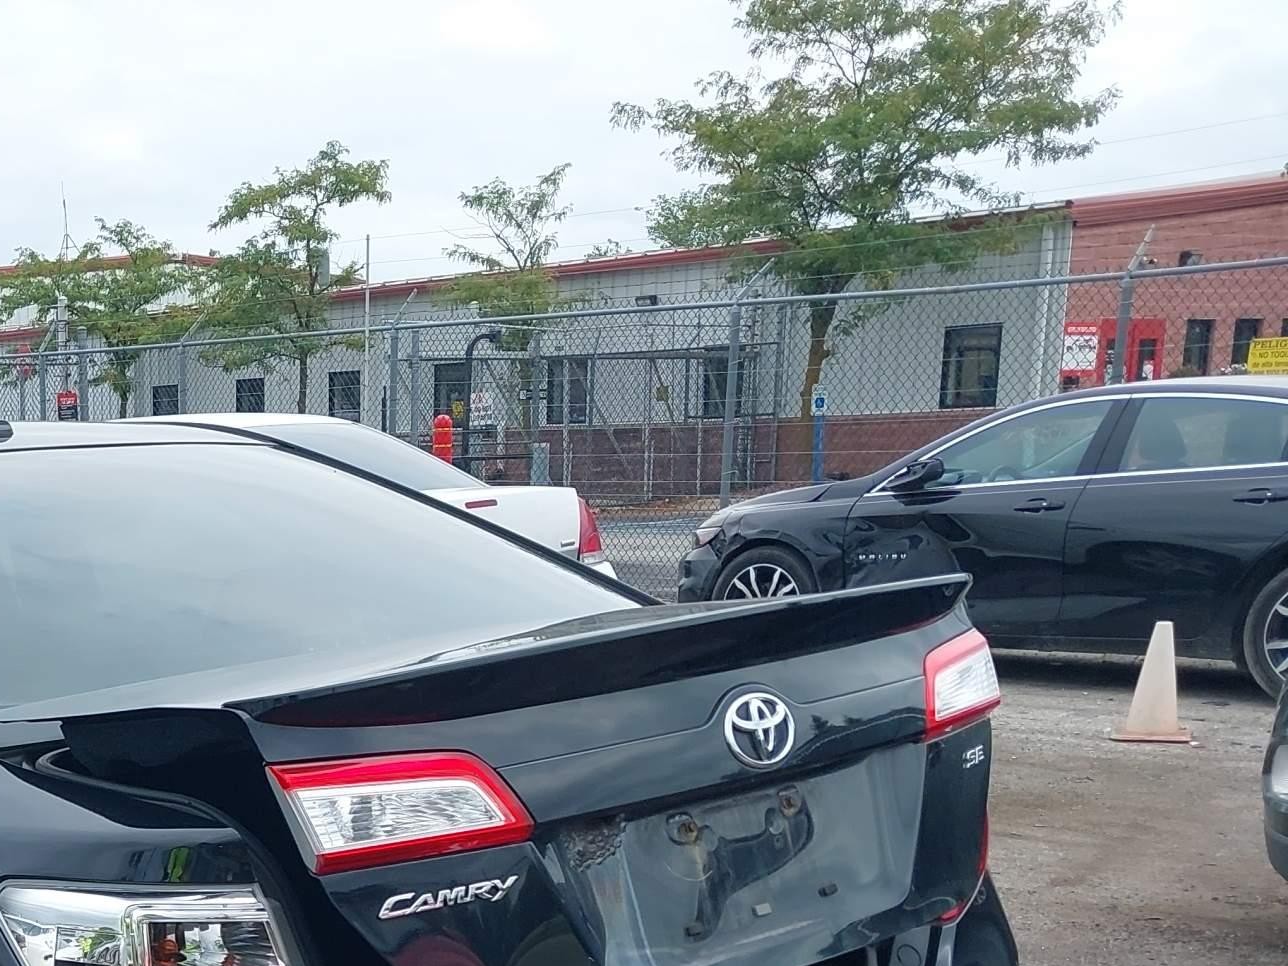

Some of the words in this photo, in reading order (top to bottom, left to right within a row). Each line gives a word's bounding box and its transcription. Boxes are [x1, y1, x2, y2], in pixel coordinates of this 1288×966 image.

[1258, 351, 1269, 359] NO
[858, 553, 907, 561] MALIBU
[963, 744, 985, 769] SE
[378, 875, 519, 919] CAMRY
